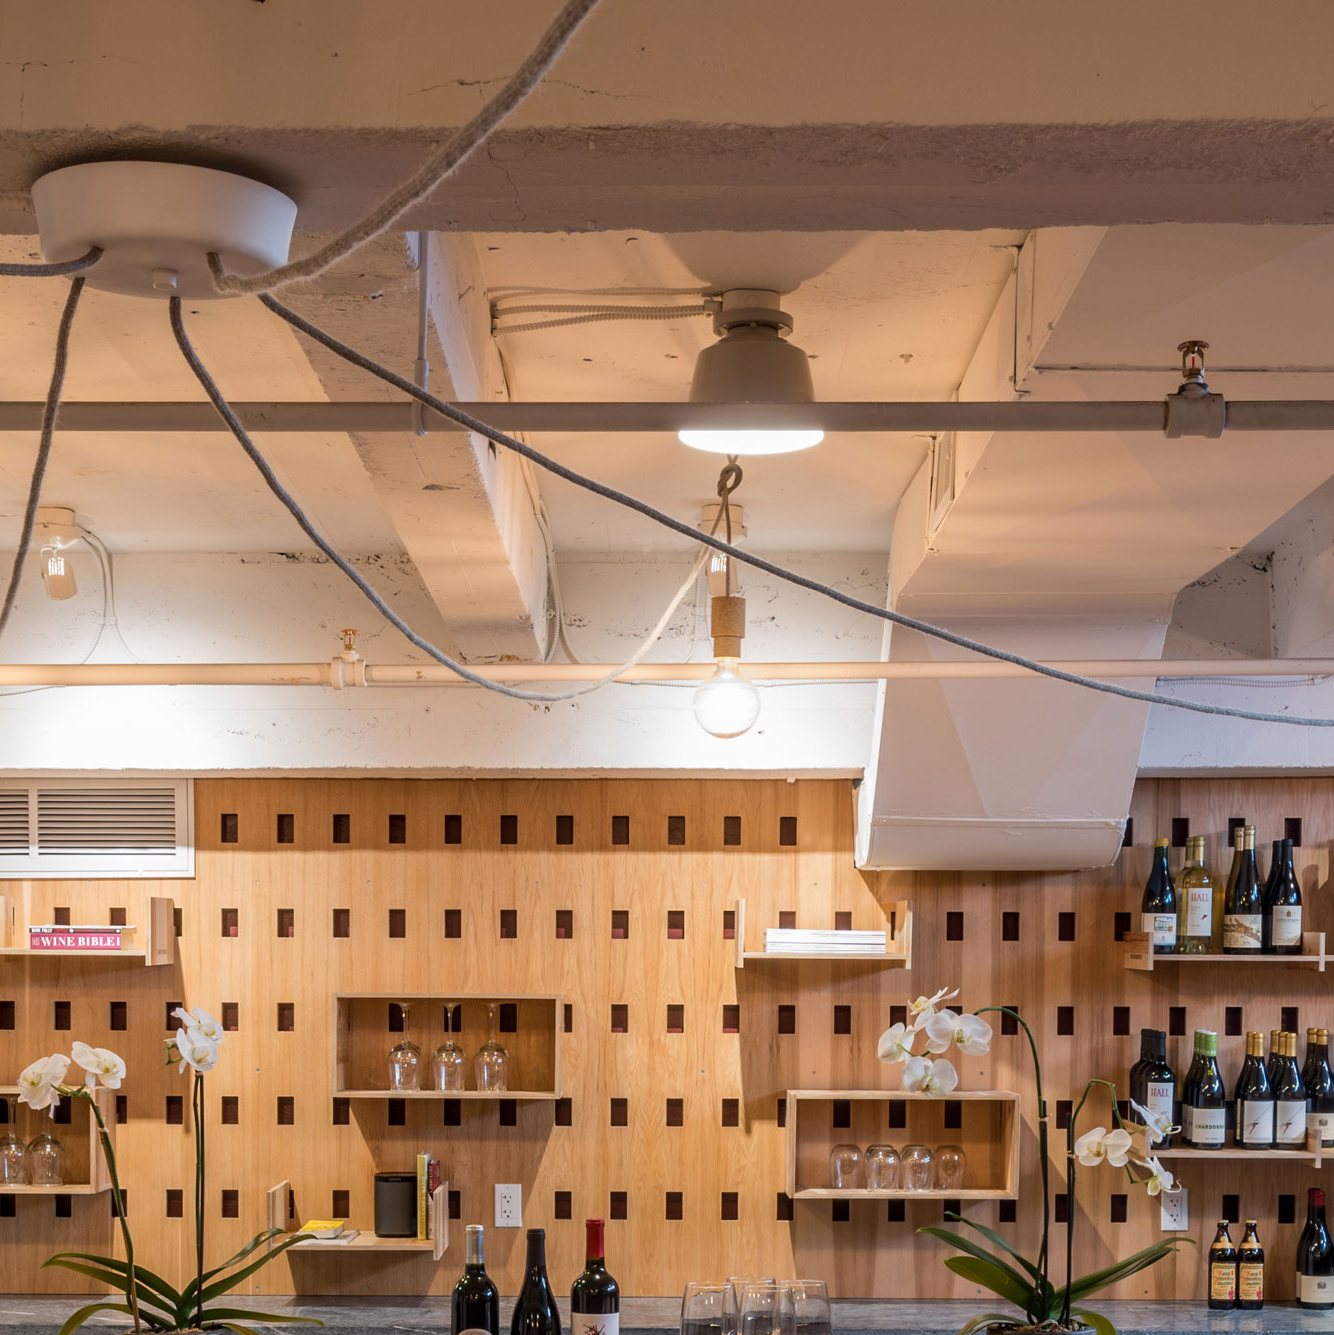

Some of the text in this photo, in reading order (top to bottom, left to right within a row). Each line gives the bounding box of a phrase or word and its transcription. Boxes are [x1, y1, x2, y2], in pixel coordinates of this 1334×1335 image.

[1191, 893, 1209, 902] HALL
[40, 936, 75, 946] WINE
[78, 936, 115, 946] BIBLE
[1150, 1088, 1170, 1097] HALL
